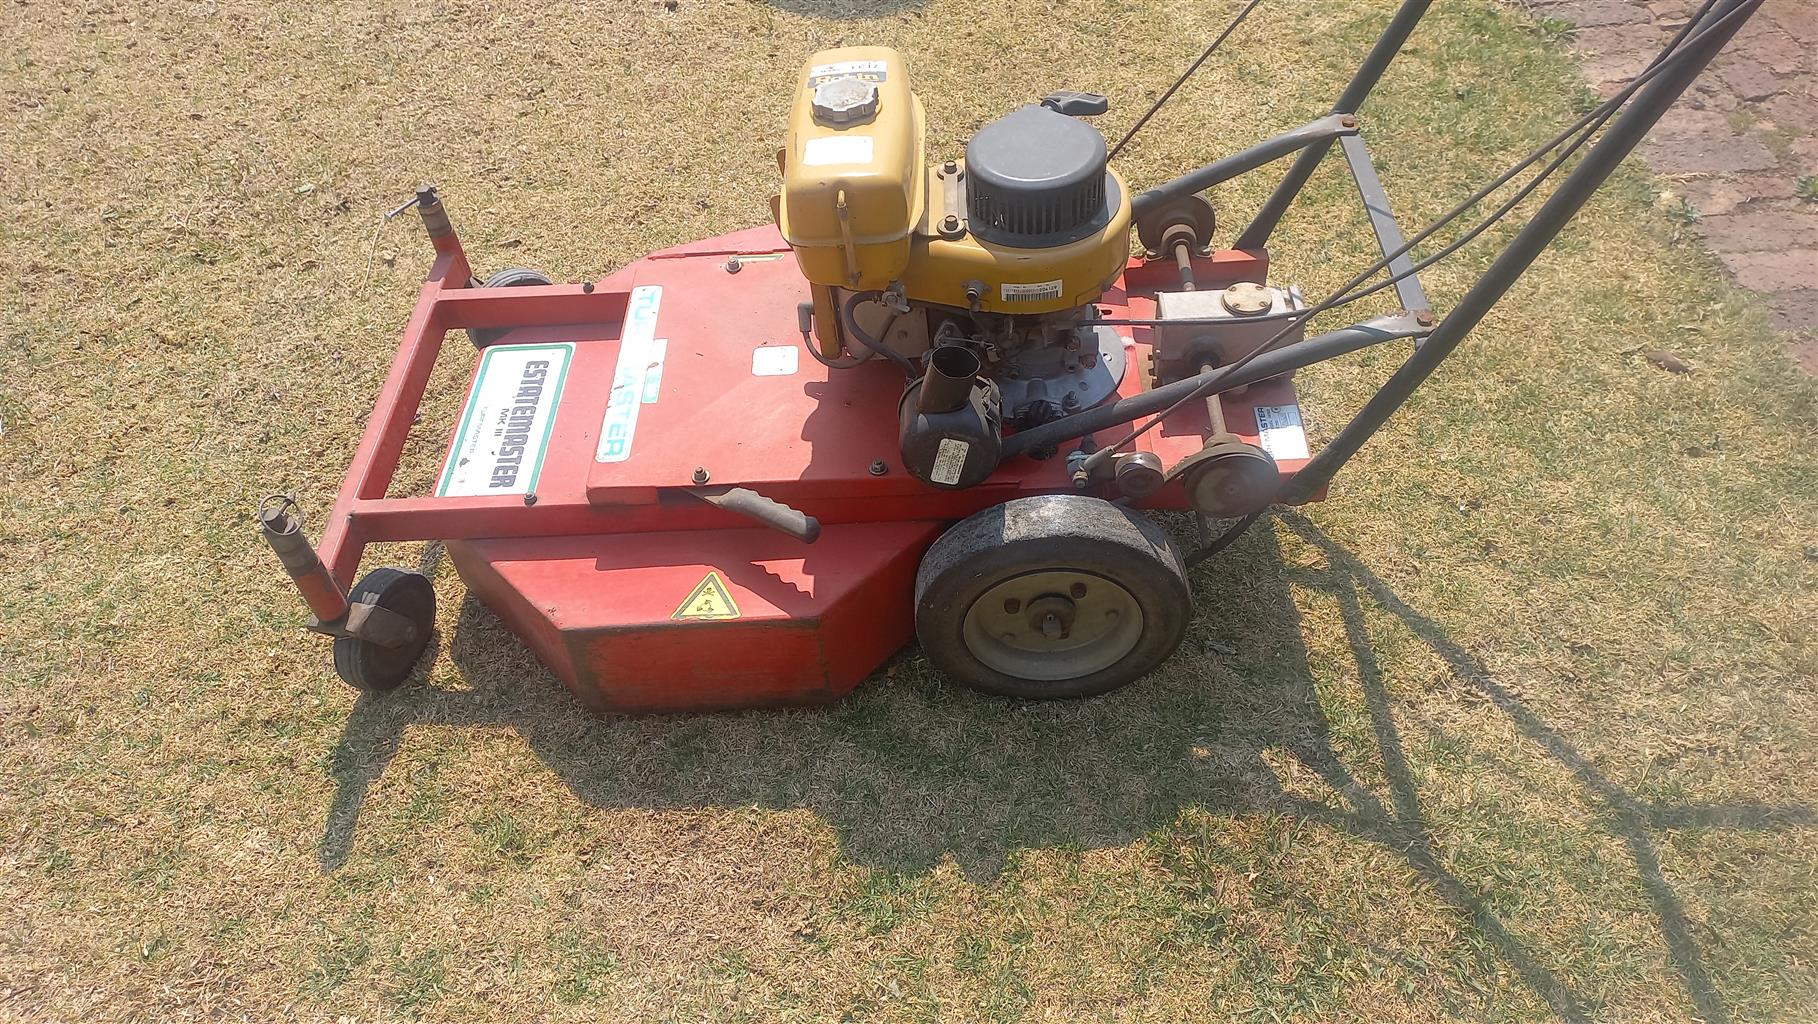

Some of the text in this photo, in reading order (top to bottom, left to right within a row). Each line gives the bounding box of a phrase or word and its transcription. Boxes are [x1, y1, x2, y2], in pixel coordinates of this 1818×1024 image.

[489, 360, 549, 488] ESTATEMASTER
[494, 408, 510, 437] MK III
